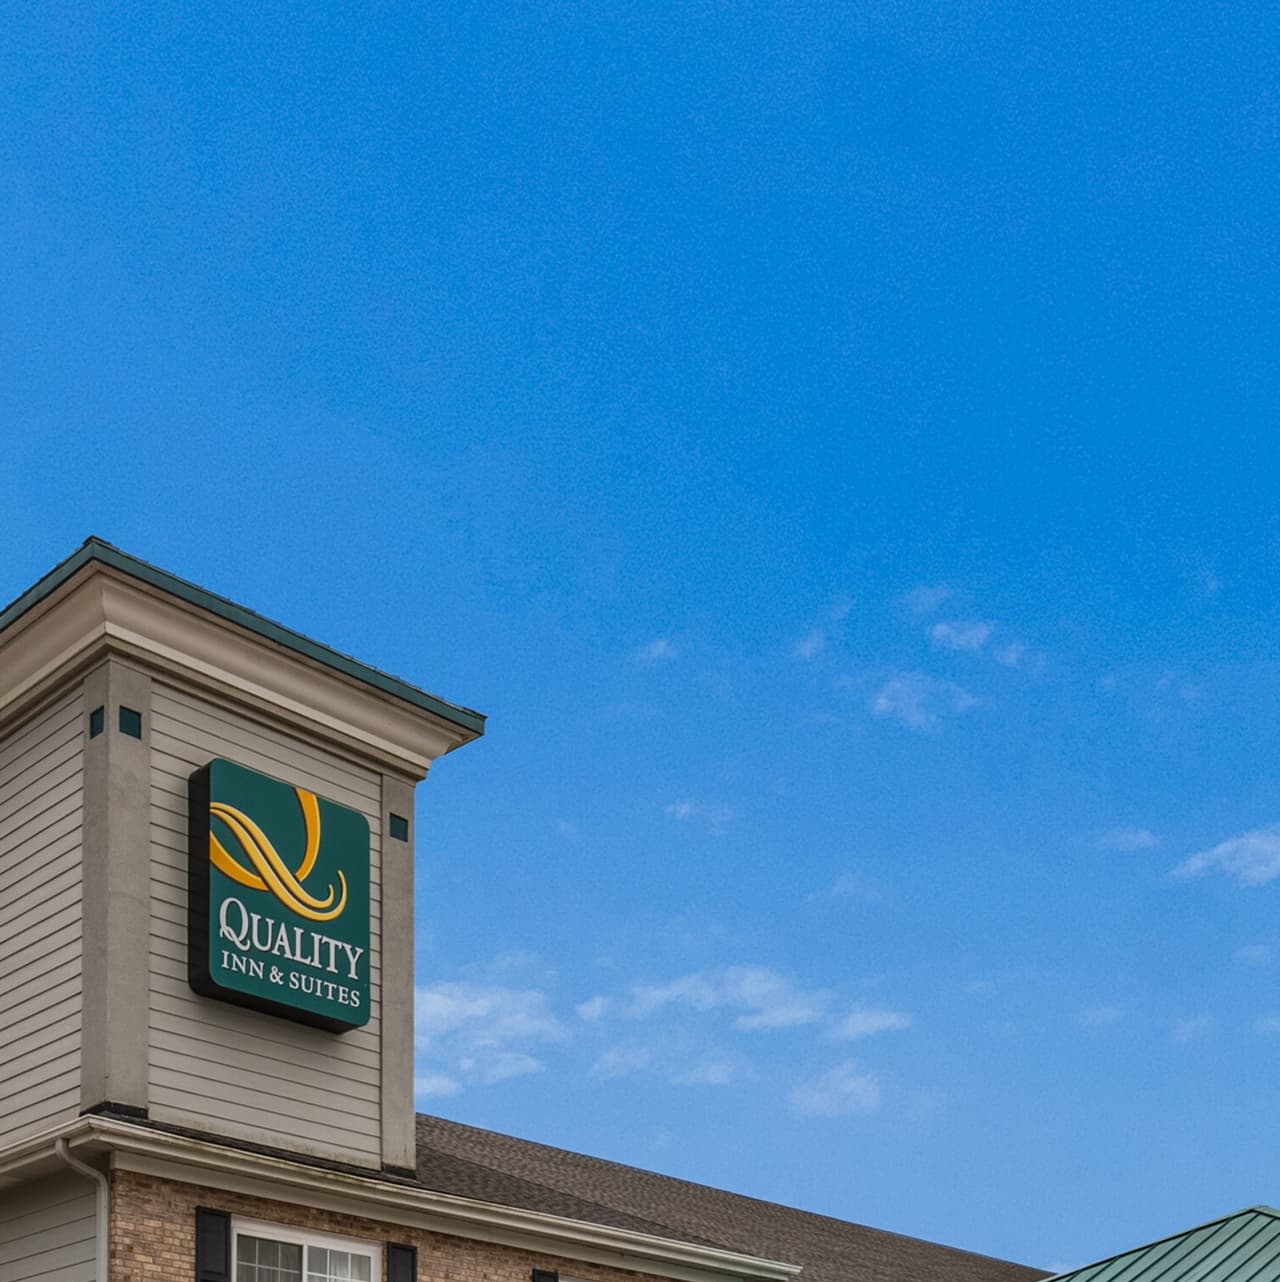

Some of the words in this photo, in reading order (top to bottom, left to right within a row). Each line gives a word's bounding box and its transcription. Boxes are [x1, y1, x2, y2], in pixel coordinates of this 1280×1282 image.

[219, 897, 363, 980] QUALITY
[221, 950, 265, 980] INN
[269, 965, 284, 985] &
[289, 971, 361, 1008] SUITES
